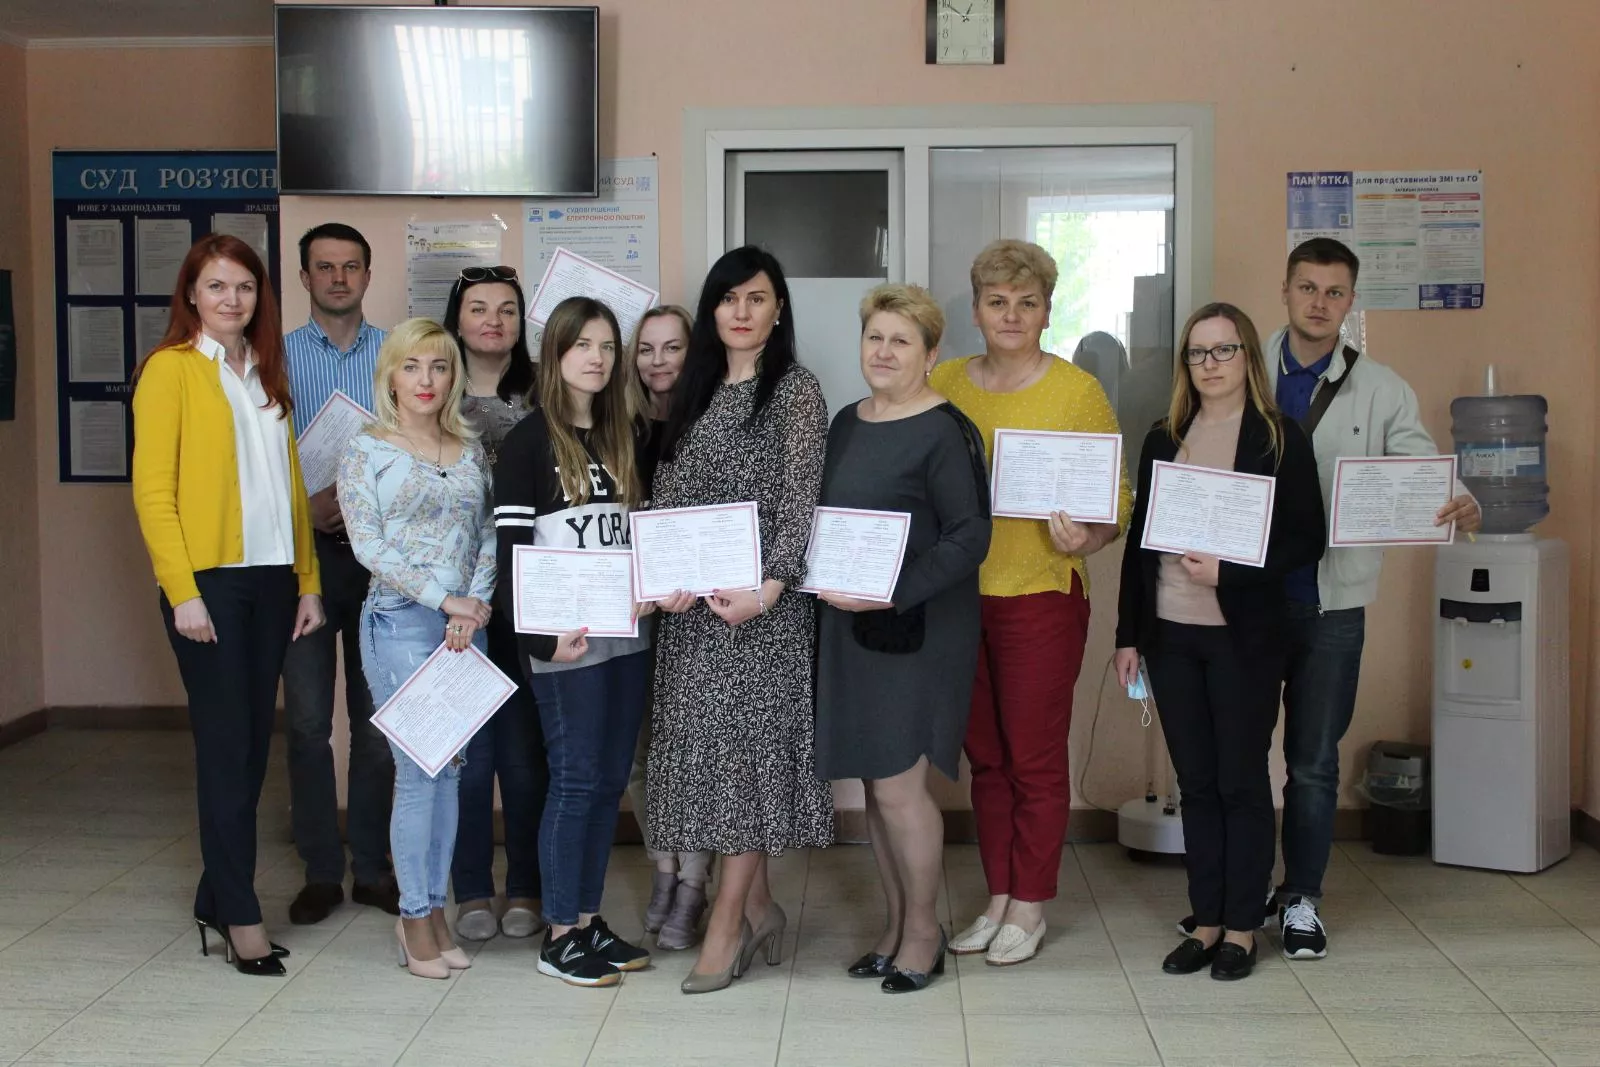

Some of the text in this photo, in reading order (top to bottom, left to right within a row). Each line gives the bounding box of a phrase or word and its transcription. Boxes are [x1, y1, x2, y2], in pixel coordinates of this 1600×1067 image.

[80, 168, 138, 194] СУД
[613, 176, 634, 186] СУД
[1292, 175, 1350, 186] ПАМ'ЯТКА
[1355, 176, 1372, 185] для
[1374, 175, 1437, 186] представників
[1439, 175, 1453, 183] ЗМІ
[1467, 175, 1478, 183] ГО
[77, 204, 181, 213] НОВЕ У ЗАКОНОДАВСТВІ
